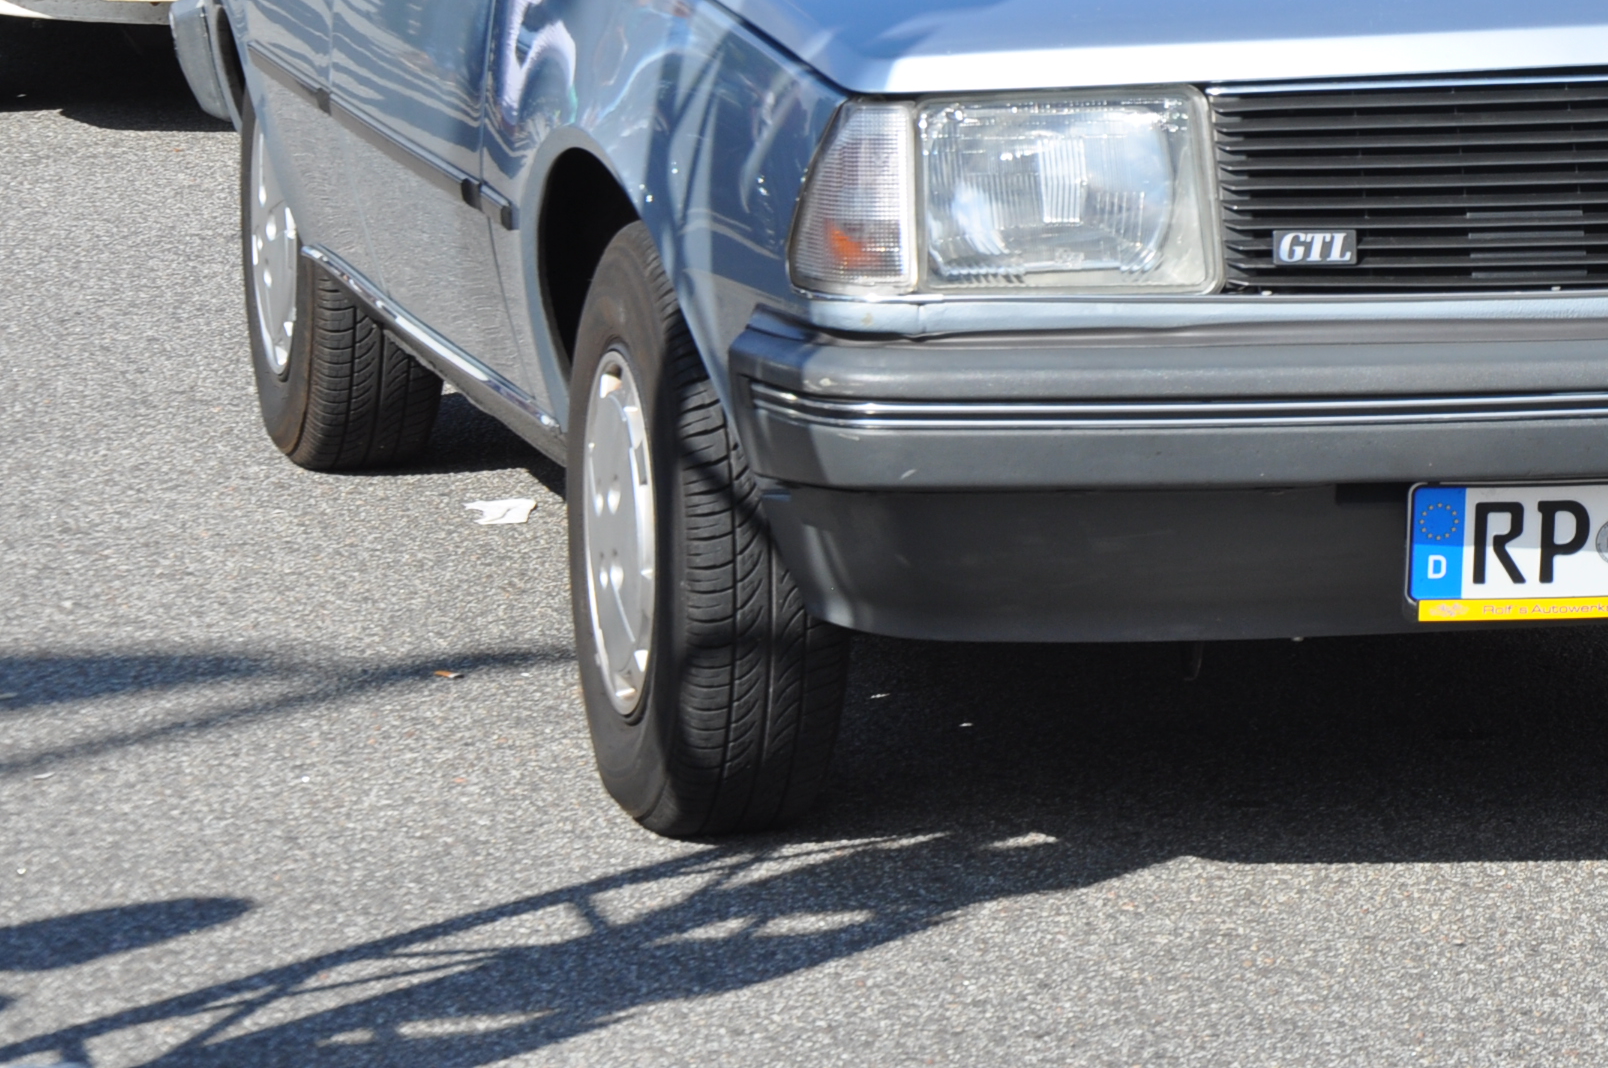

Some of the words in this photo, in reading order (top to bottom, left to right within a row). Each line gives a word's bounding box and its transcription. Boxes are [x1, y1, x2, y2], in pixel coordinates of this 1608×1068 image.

[1280, 232, 1352, 262] GTL
[1472, 499, 1591, 585] RP
[1427, 555, 1447, 579] D
